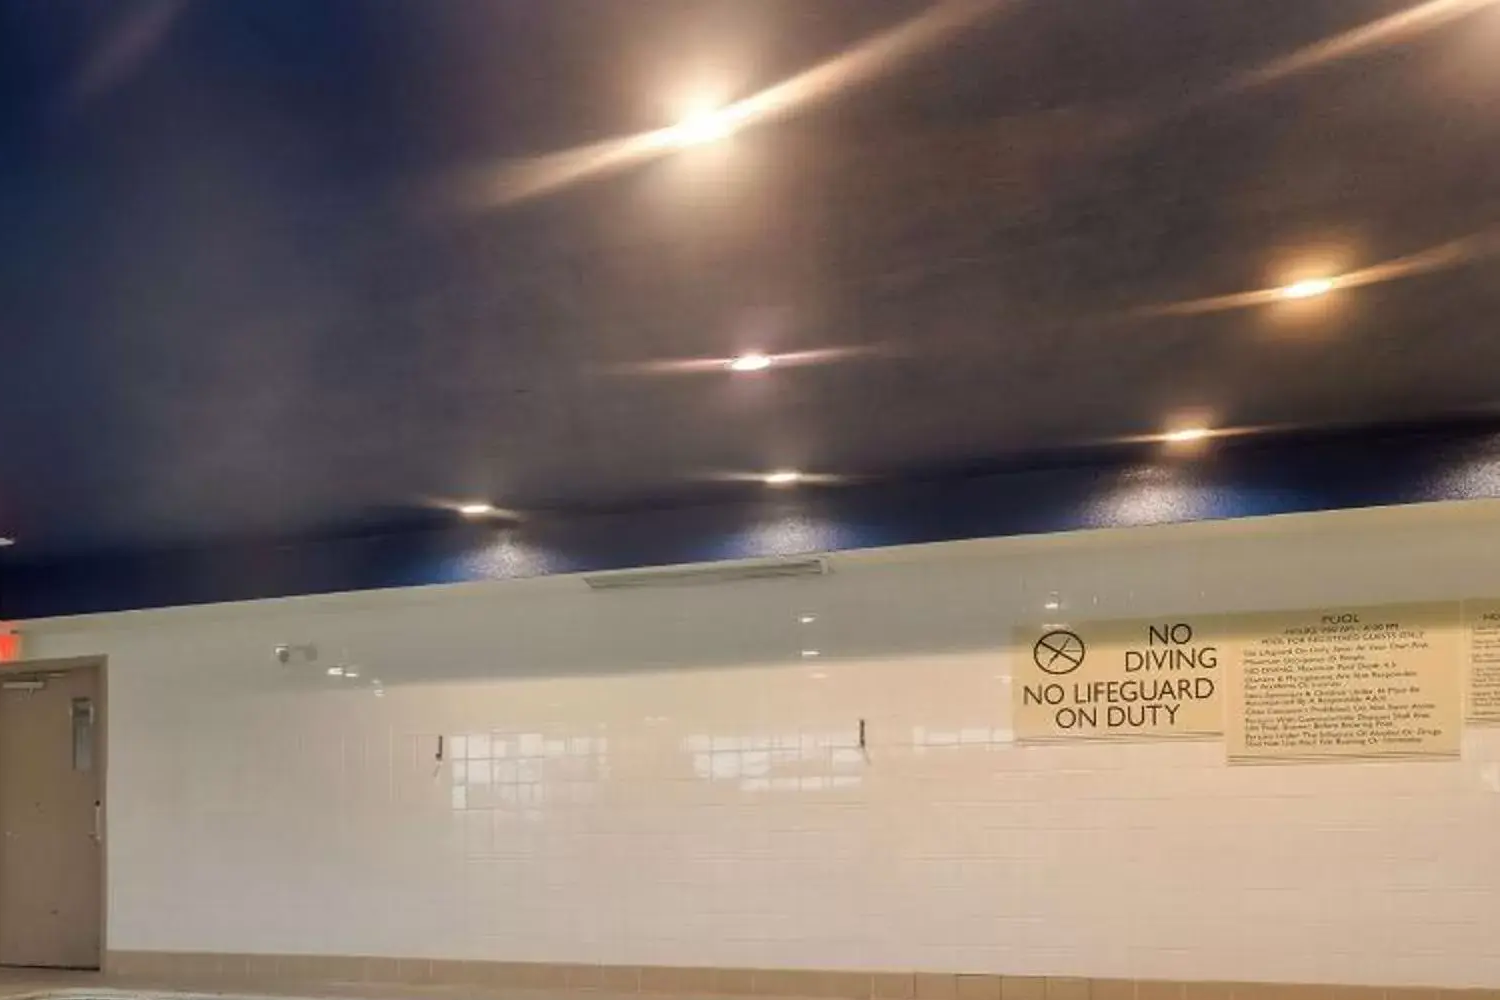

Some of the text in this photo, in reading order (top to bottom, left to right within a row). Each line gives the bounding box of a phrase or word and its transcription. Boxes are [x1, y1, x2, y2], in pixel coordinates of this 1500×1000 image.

[1322, 613, 1360, 624] POOL
[1150, 623, 1192, 645] NO
[1125, 648, 1217, 672] DIVING
[1024, 678, 1215, 705] NO LIFEGUARD
[1056, 704, 1180, 728] ON DUTY
